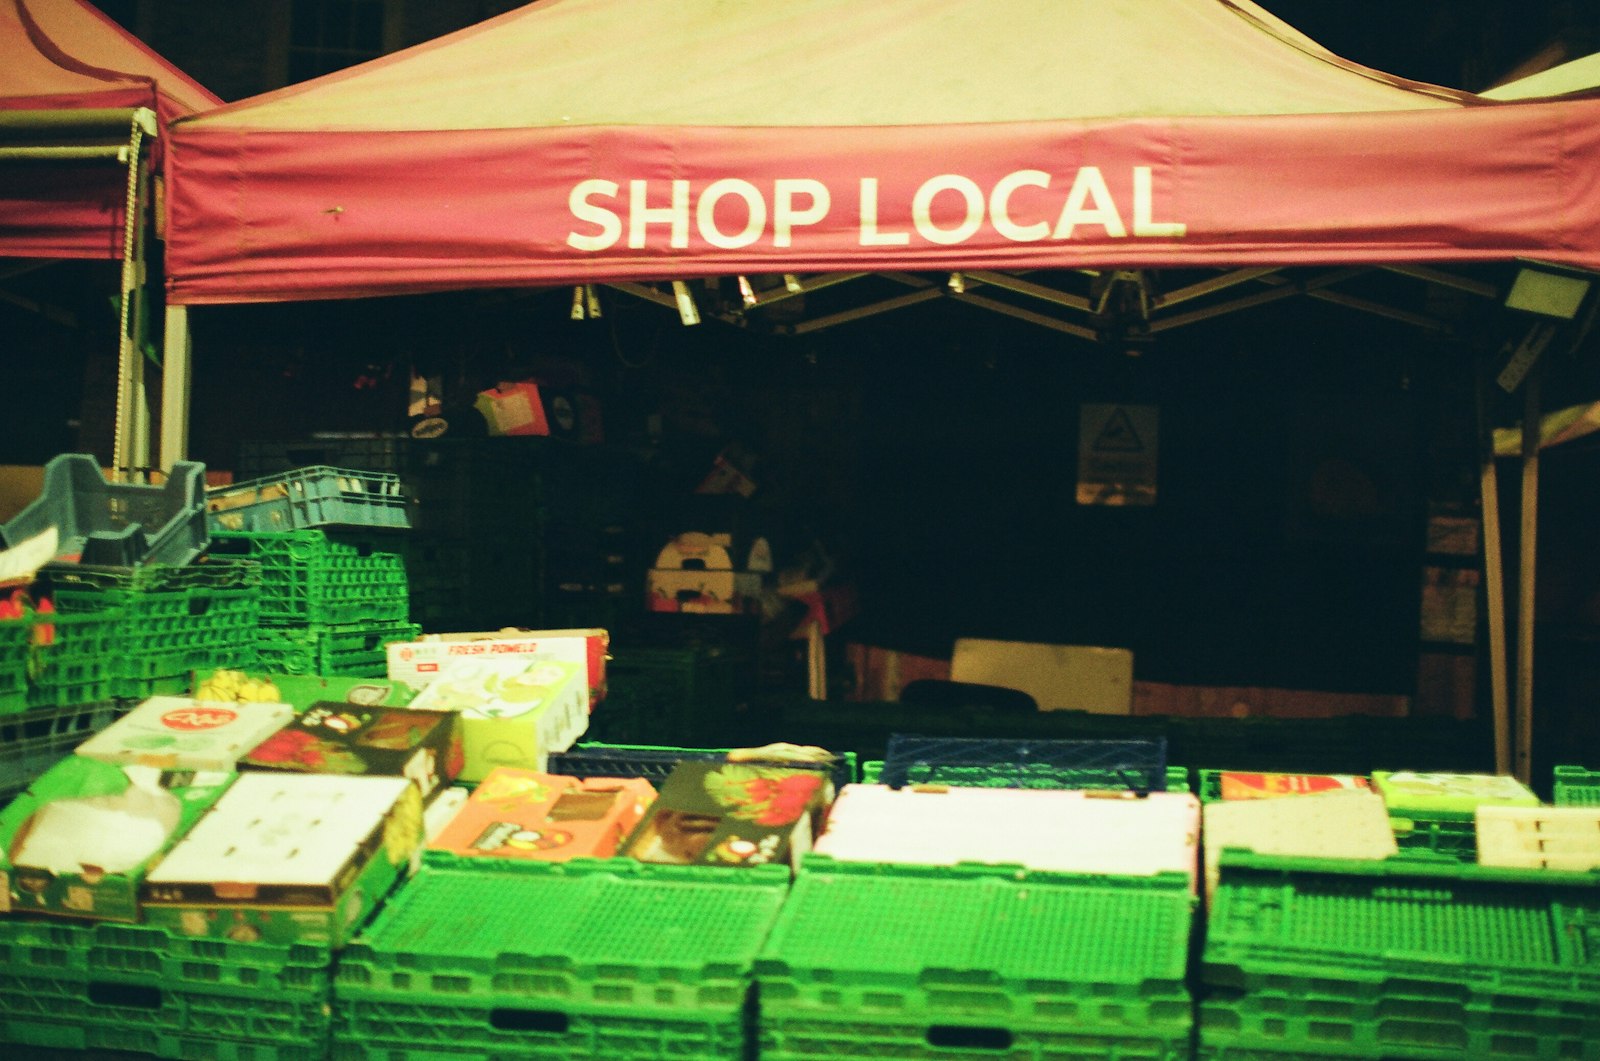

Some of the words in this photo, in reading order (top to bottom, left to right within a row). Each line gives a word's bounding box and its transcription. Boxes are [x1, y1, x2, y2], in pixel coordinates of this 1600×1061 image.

[566, 178, 831, 251] SHOP
[859, 166, 1187, 246] LOCAL
[449, 644, 485, 655] FRESH
[491, 642, 537, 654] POMELO
